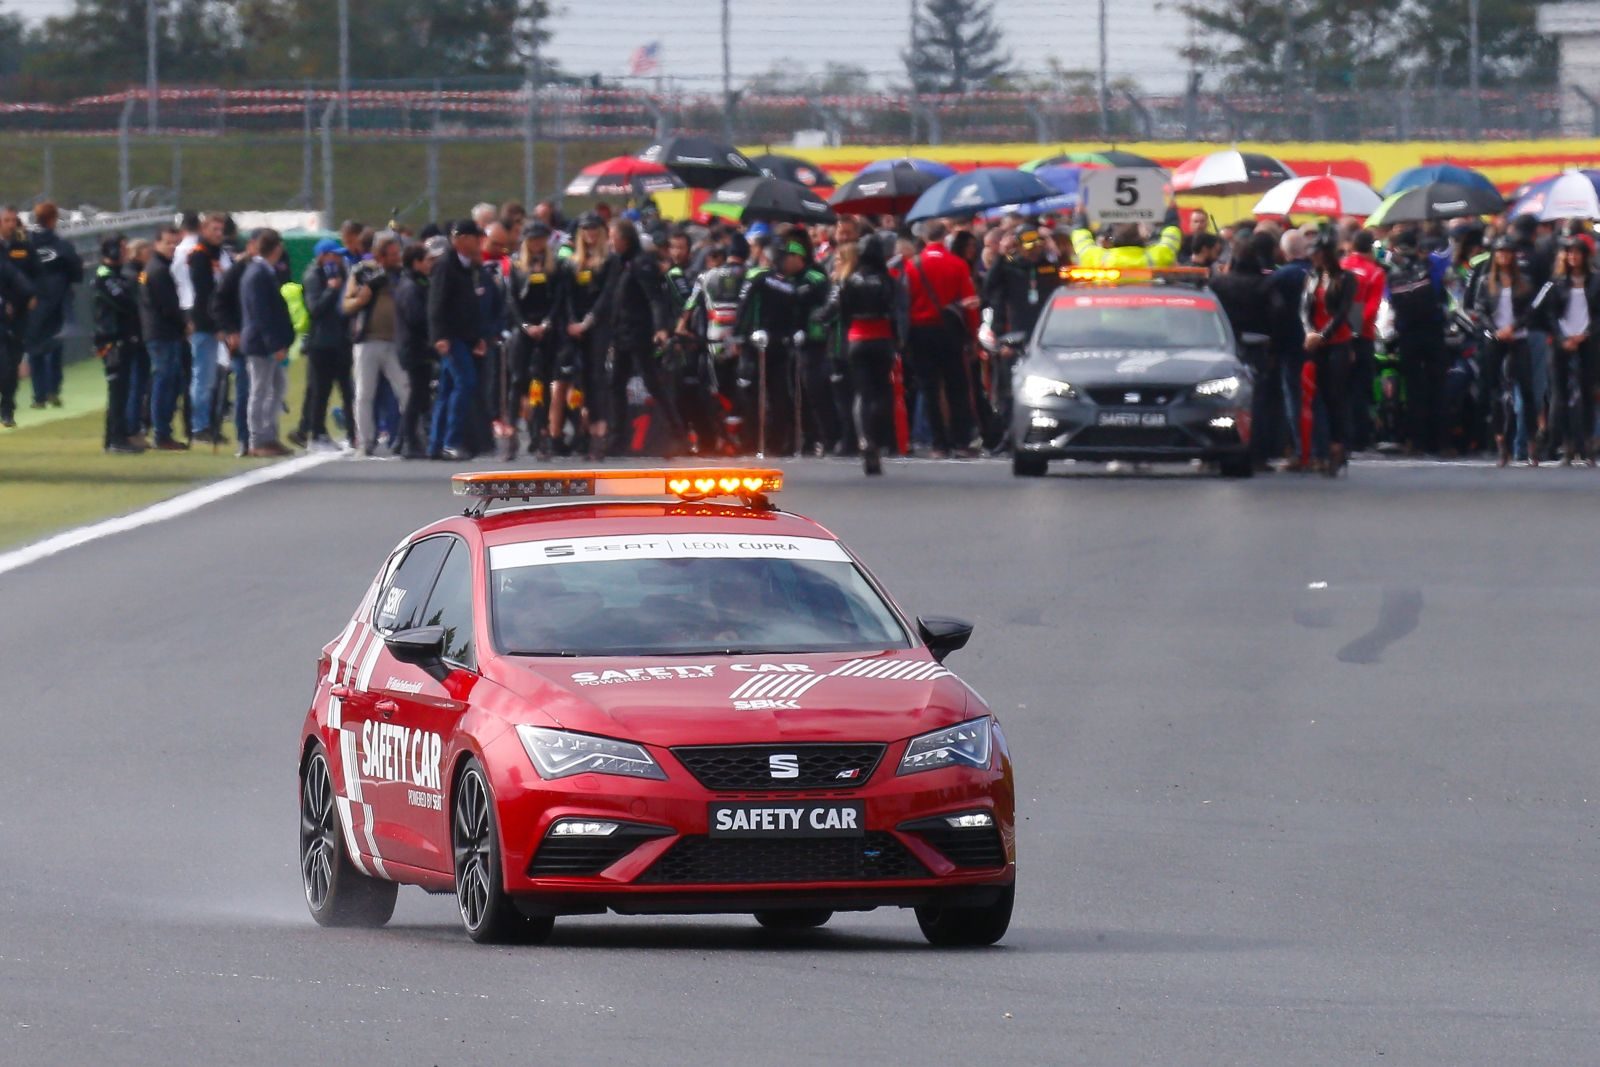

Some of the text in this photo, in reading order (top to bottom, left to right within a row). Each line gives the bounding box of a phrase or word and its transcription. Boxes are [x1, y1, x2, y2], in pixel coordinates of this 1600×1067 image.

[1115, 177, 1139, 206] 5
[584, 542, 660, 552] SEAT
[682, 541, 729, 550] LEON
[738, 542, 800, 551] CUPRA
[571, 663, 815, 682] SAFETY CAR
[579, 675, 652, 686] POWERED
[362, 718, 441, 790] SAFETY CAR
[716, 807, 858, 831] SAFETY CAR
